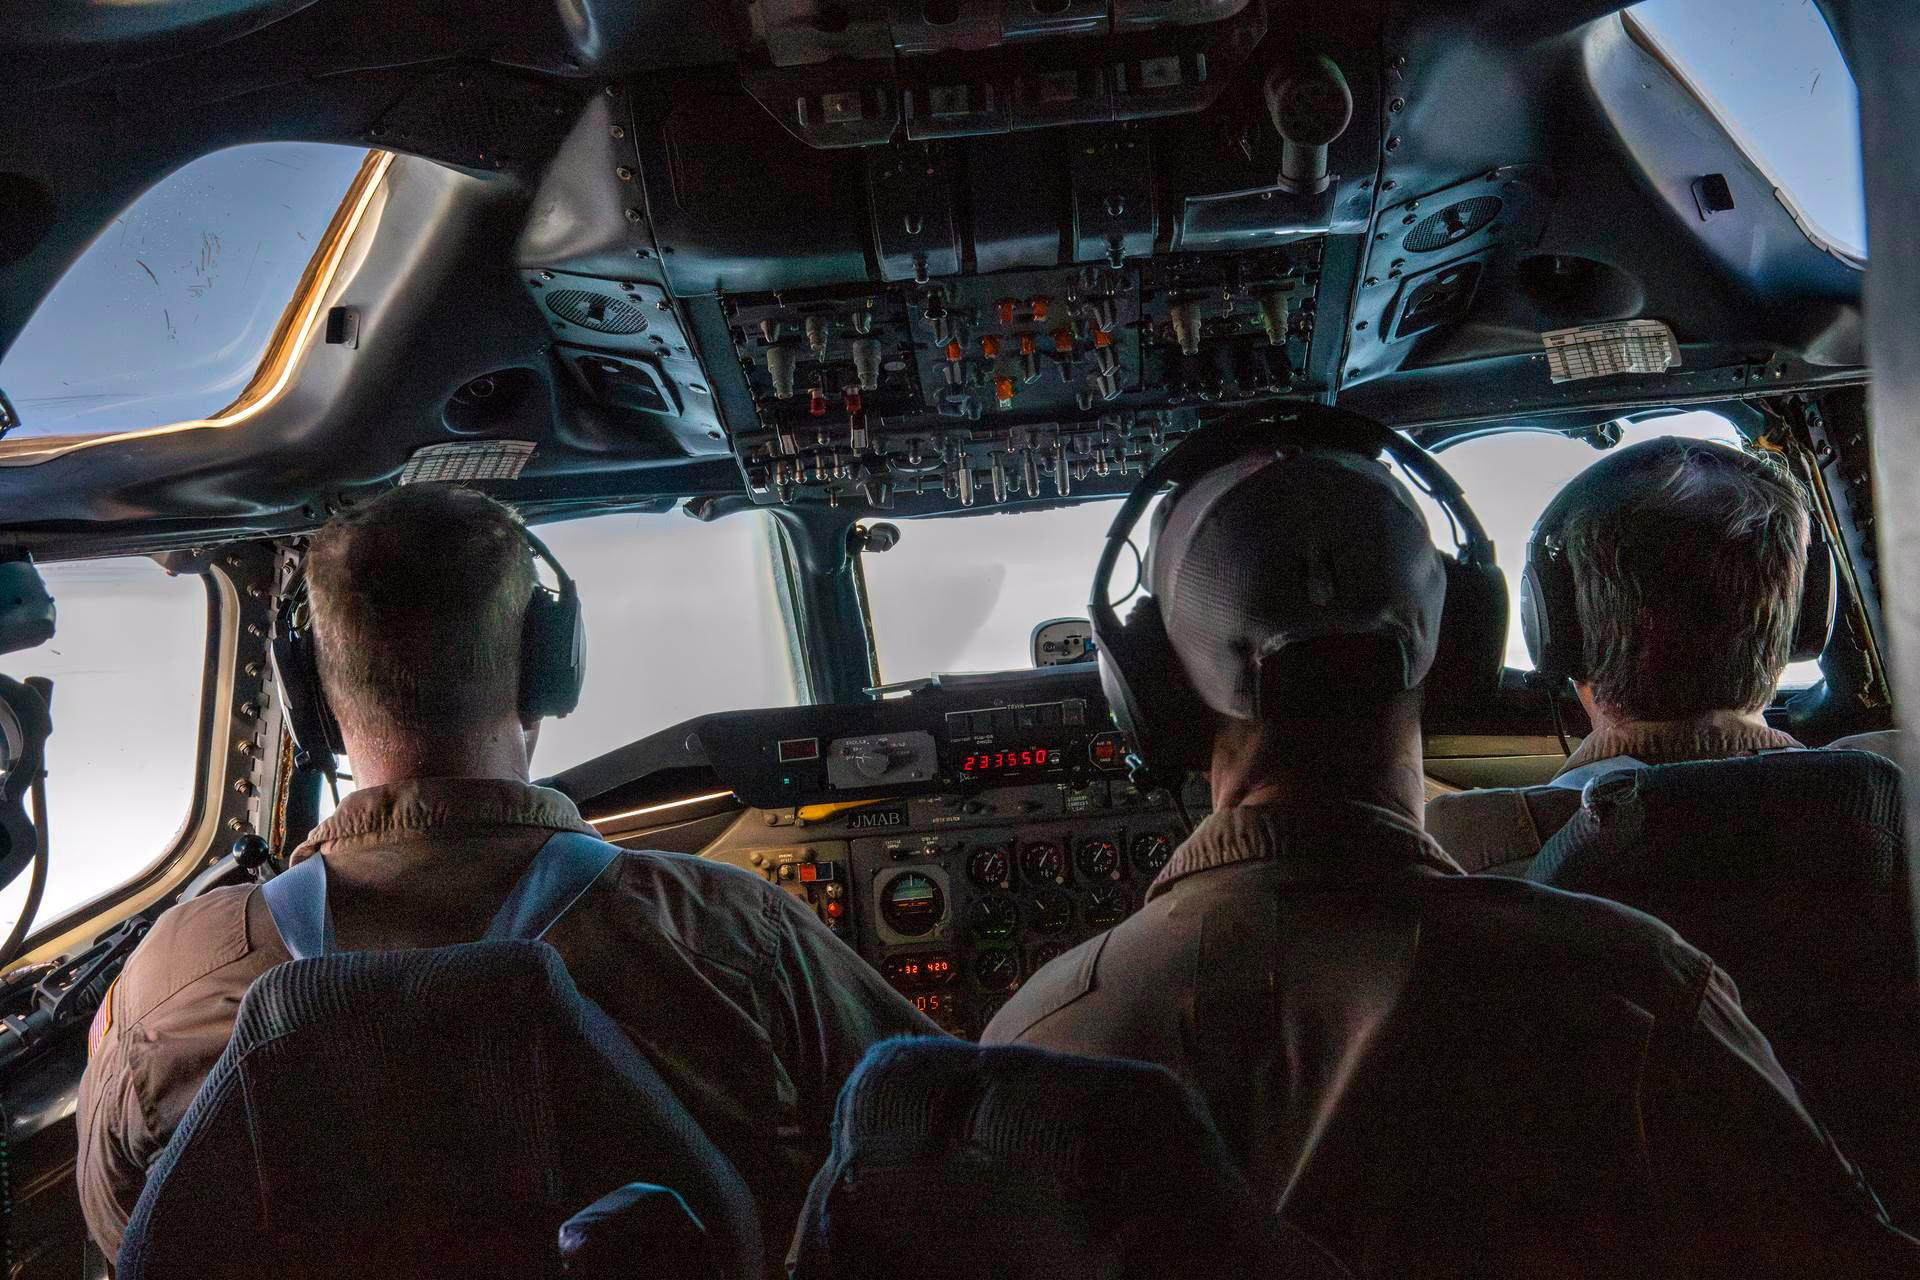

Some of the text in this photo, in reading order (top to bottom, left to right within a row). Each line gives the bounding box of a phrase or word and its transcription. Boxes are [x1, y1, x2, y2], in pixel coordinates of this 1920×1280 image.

[963, 749, 1047, 771] 233550
[852, 812, 901, 828] JMAB
[927, 961, 948, 971] 420
